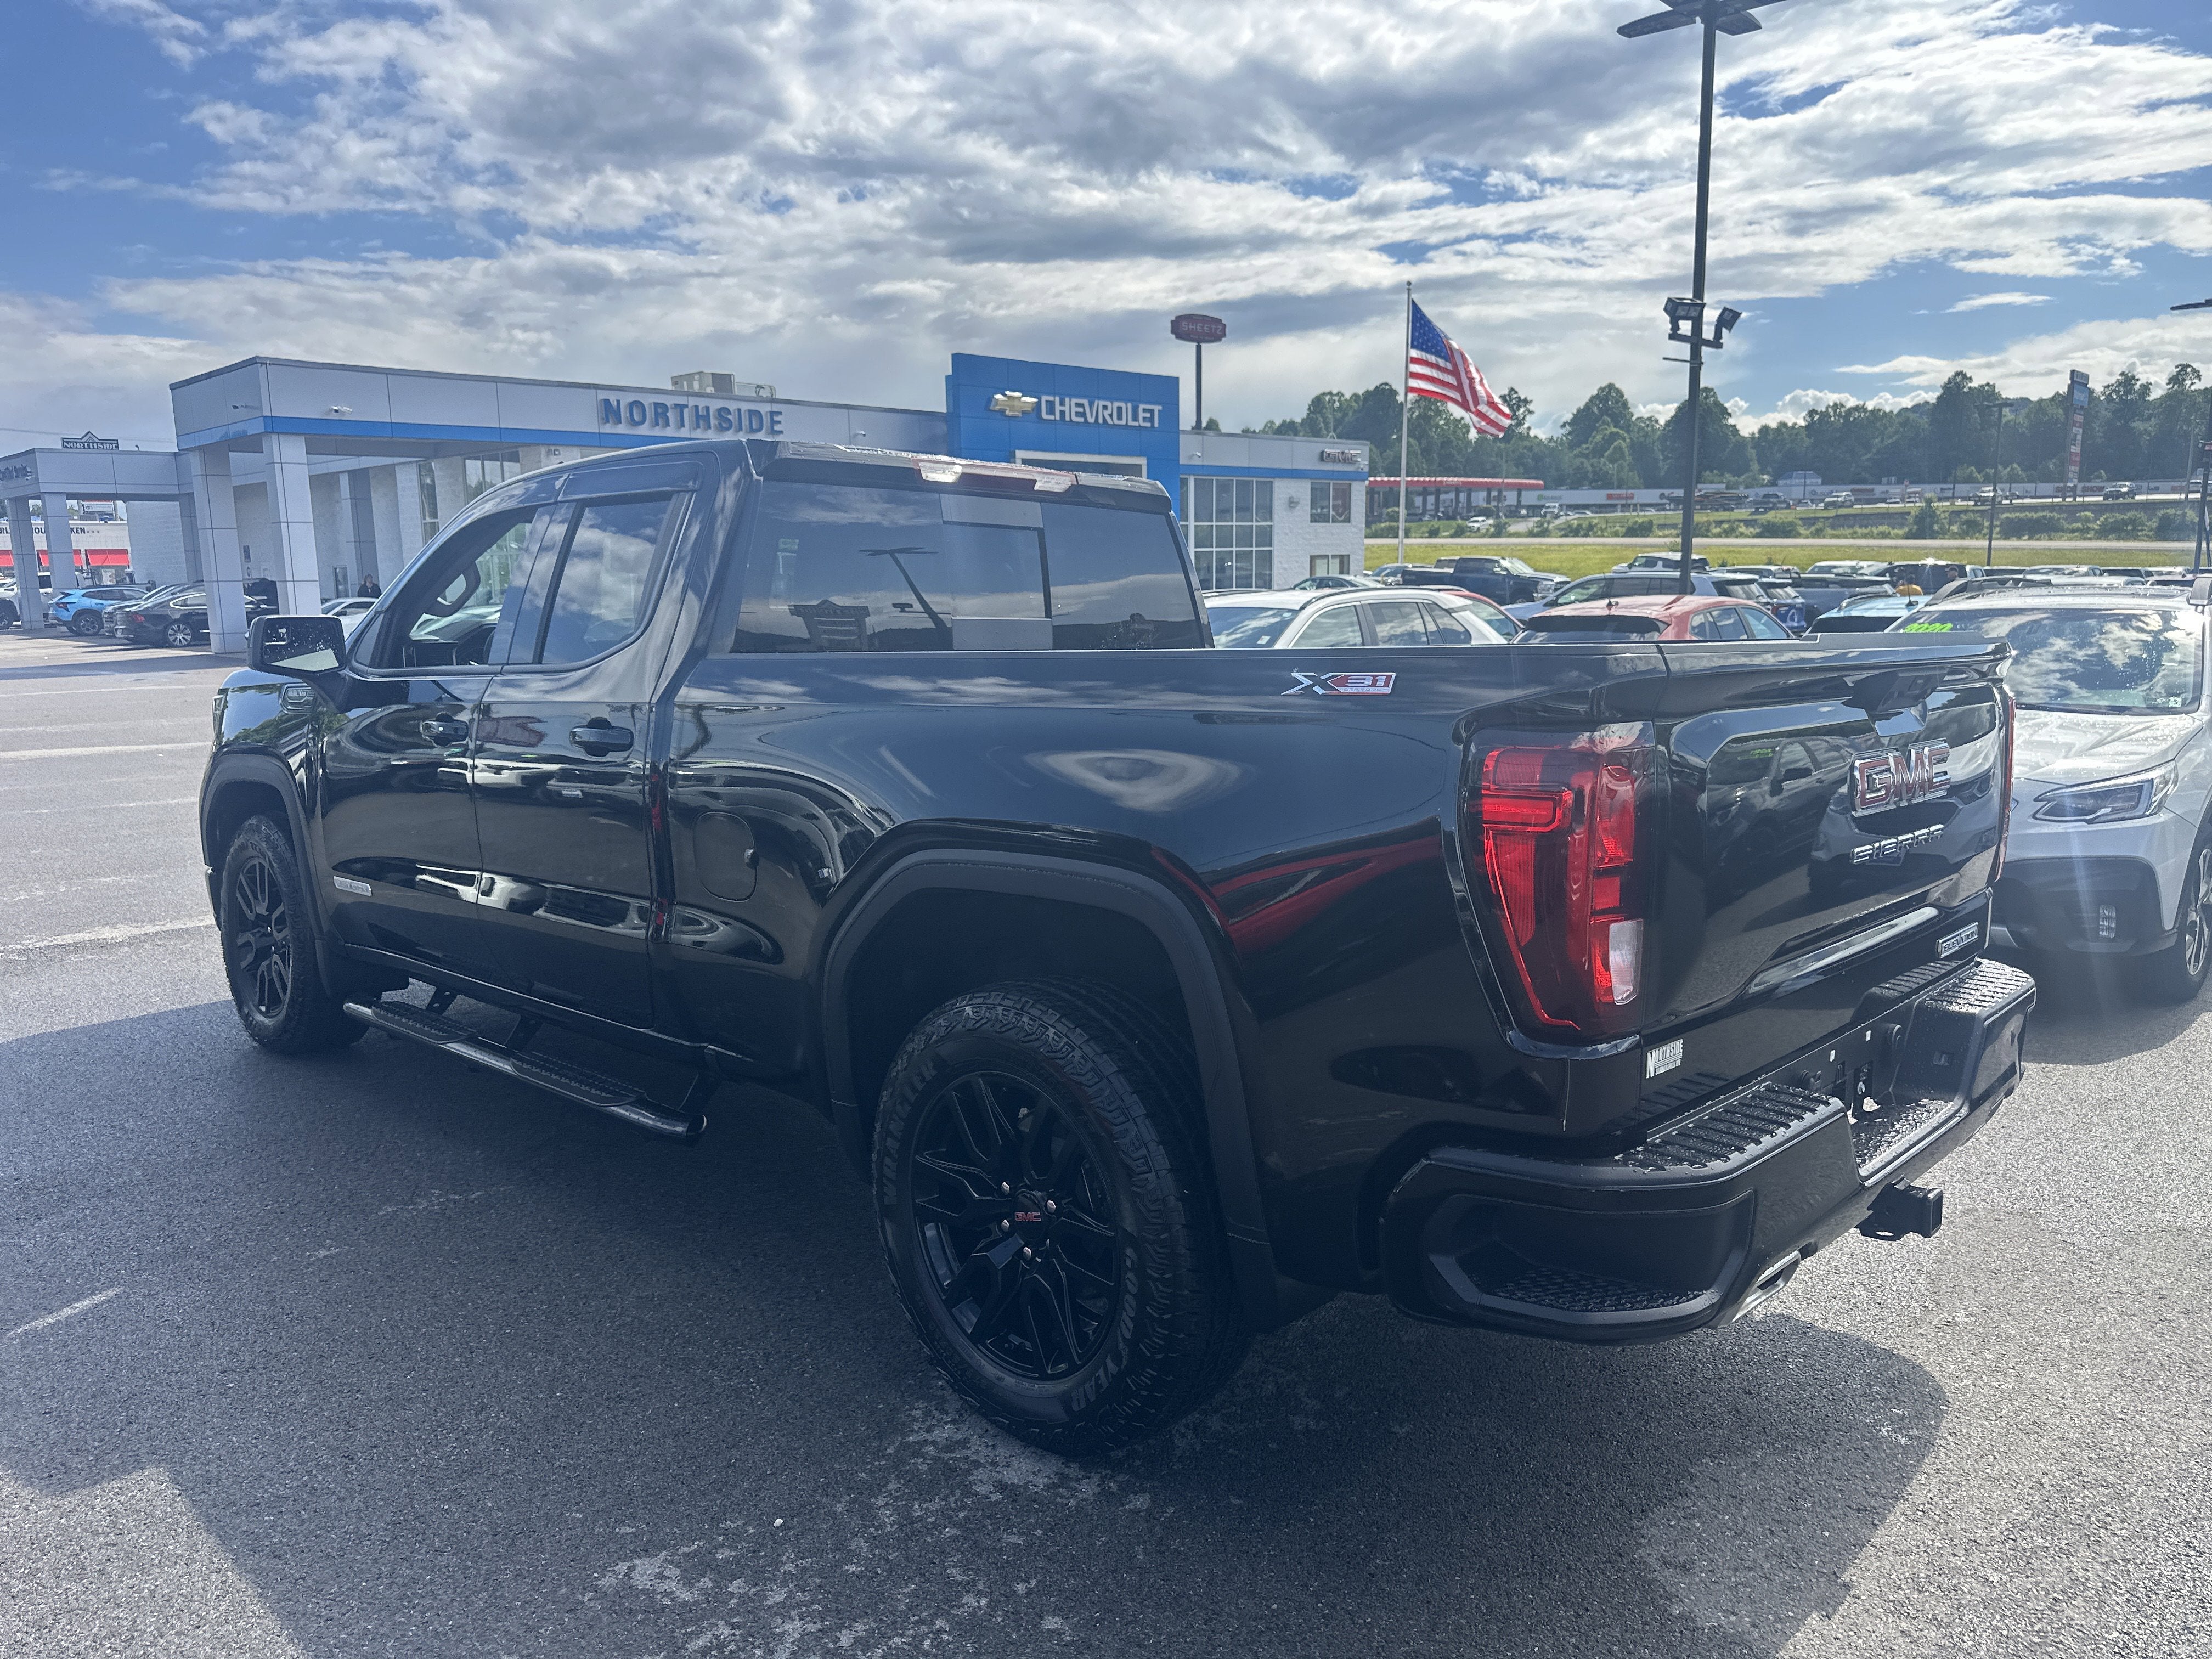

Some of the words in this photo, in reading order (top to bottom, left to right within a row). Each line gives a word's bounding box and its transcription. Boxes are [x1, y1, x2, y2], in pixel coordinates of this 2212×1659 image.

[1181, 322, 1223, 334] SHEETZ
[599, 398, 784, 435] NORTHSIDE
[1041, 395, 1163, 428] CHEVROLET
[63, 441, 117, 450] NORTHSIDE
[1322, 448, 1361, 464] GMC
[1281, 672, 1397, 695] X31
[1852, 741, 1951, 814] GMC
[1852, 824, 1944, 864] SIERRA
[1646, 1039, 1683, 1079] NORTHSIDE
[883, 1057, 938, 1206] WRANGLER
[1014, 1212, 1041, 1222] GMC
